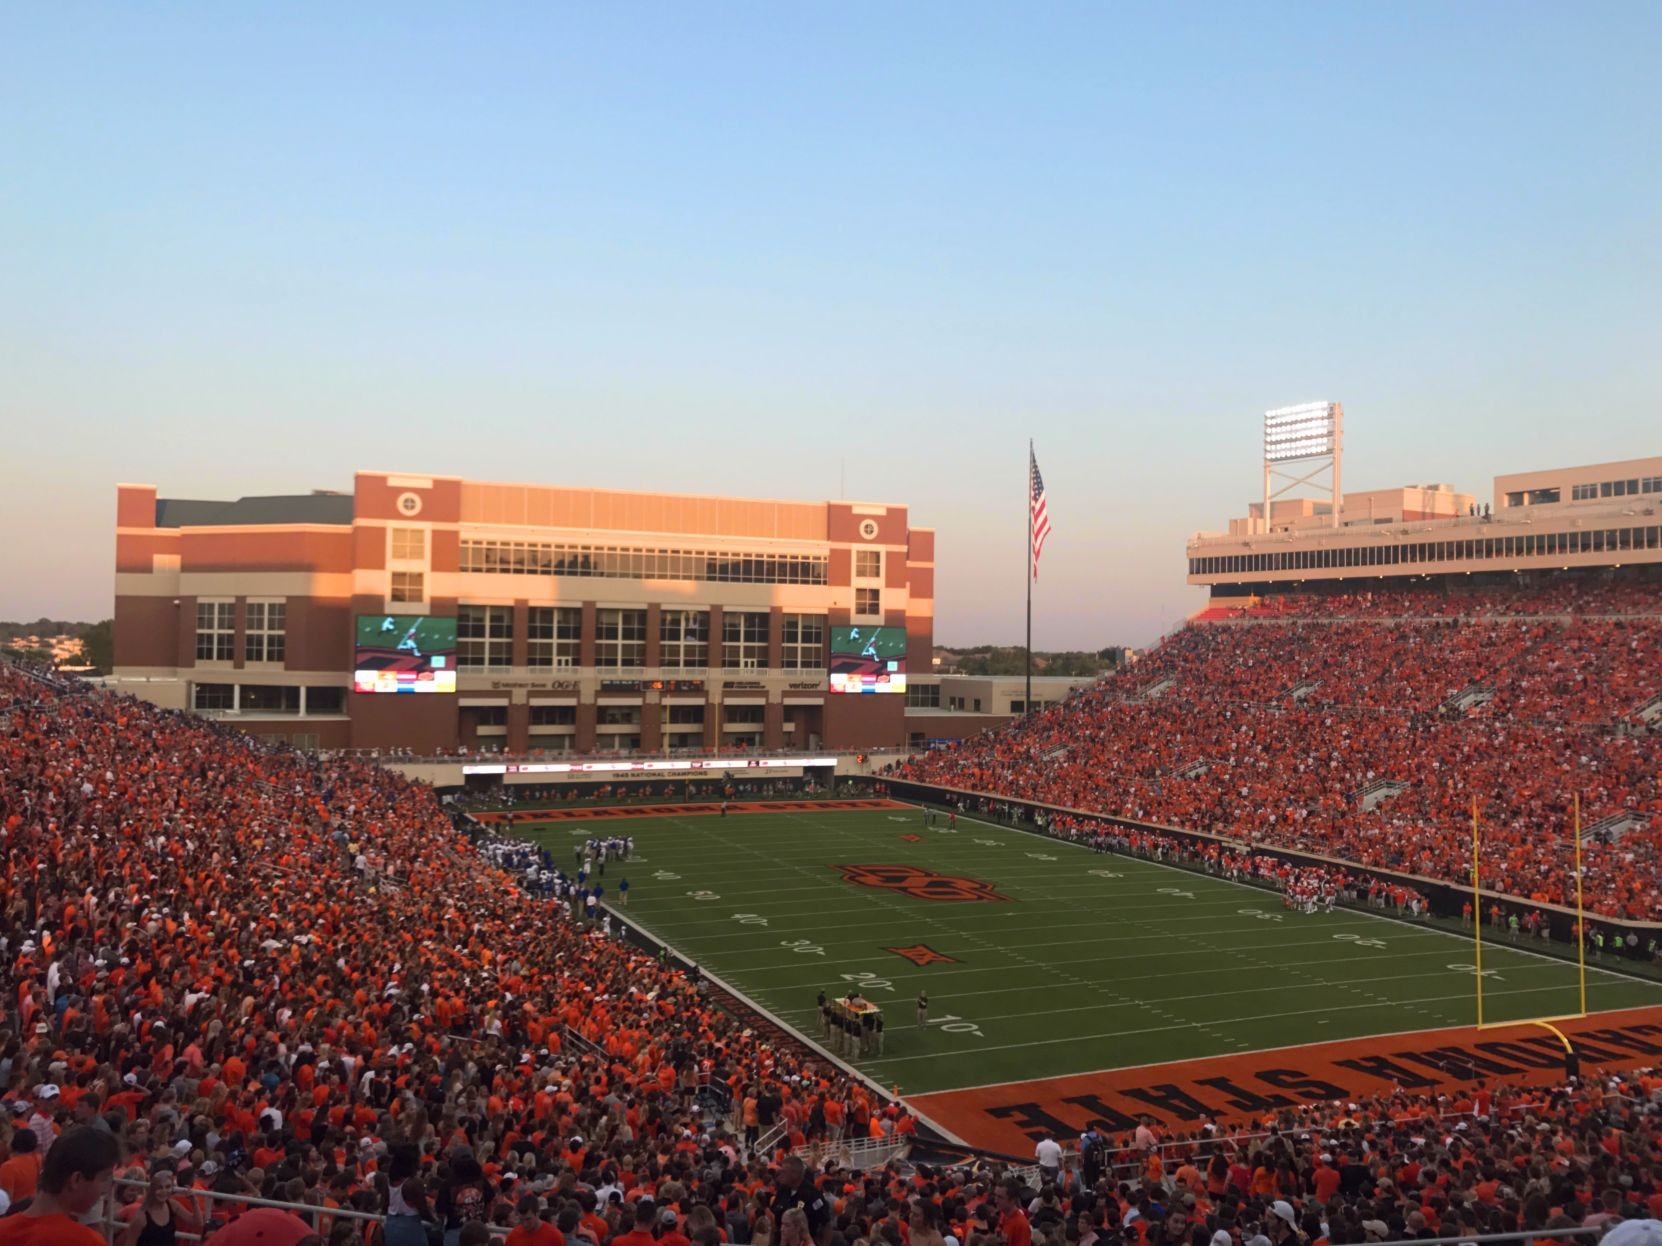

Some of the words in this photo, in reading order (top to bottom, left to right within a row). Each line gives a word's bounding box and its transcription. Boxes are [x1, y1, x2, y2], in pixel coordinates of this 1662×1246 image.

[780, 939, 824, 953] 30
[839, 972, 893, 988] 20
[926, 1014, 979, 1033] 10
[985, 1069, 1351, 1142] STATE
